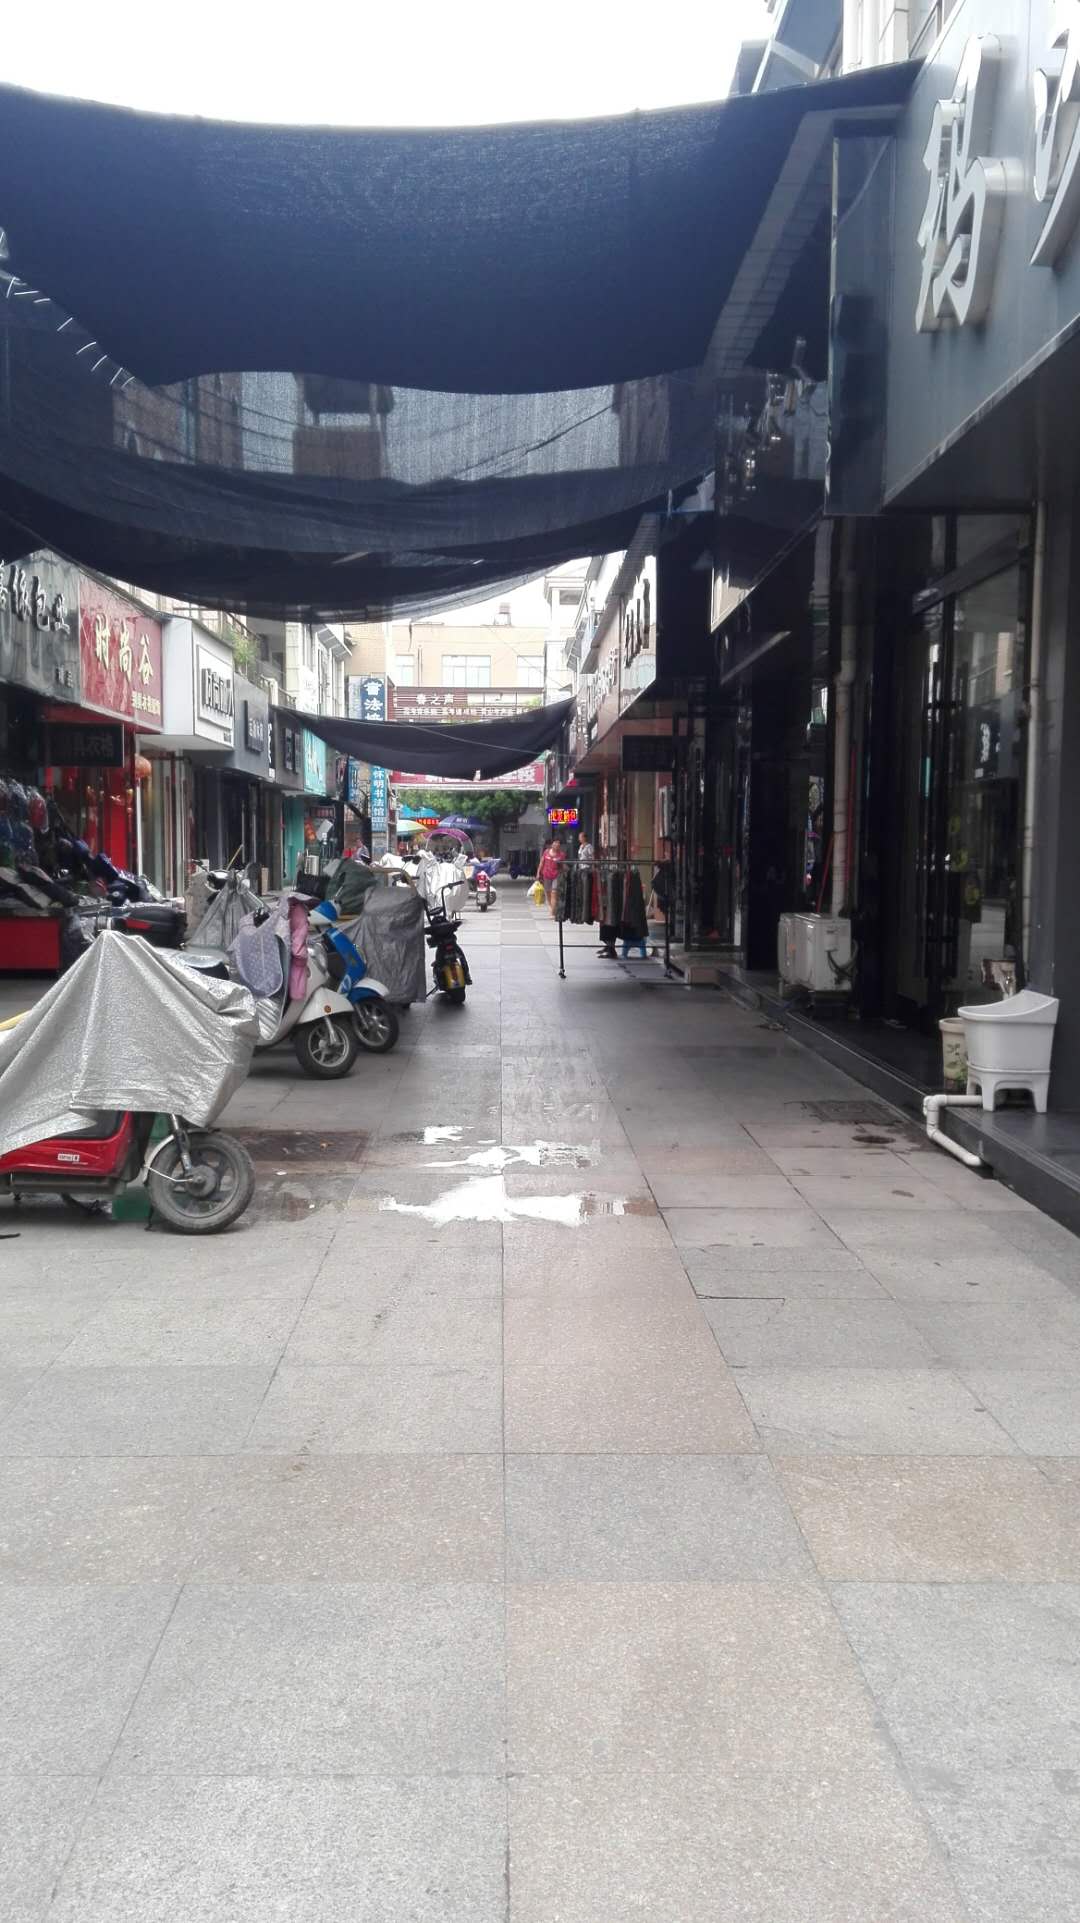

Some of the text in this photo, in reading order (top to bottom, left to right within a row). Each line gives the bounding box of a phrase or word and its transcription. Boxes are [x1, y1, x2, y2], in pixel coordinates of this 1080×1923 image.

[371, 766, 385, 817] 怀明书法馆
